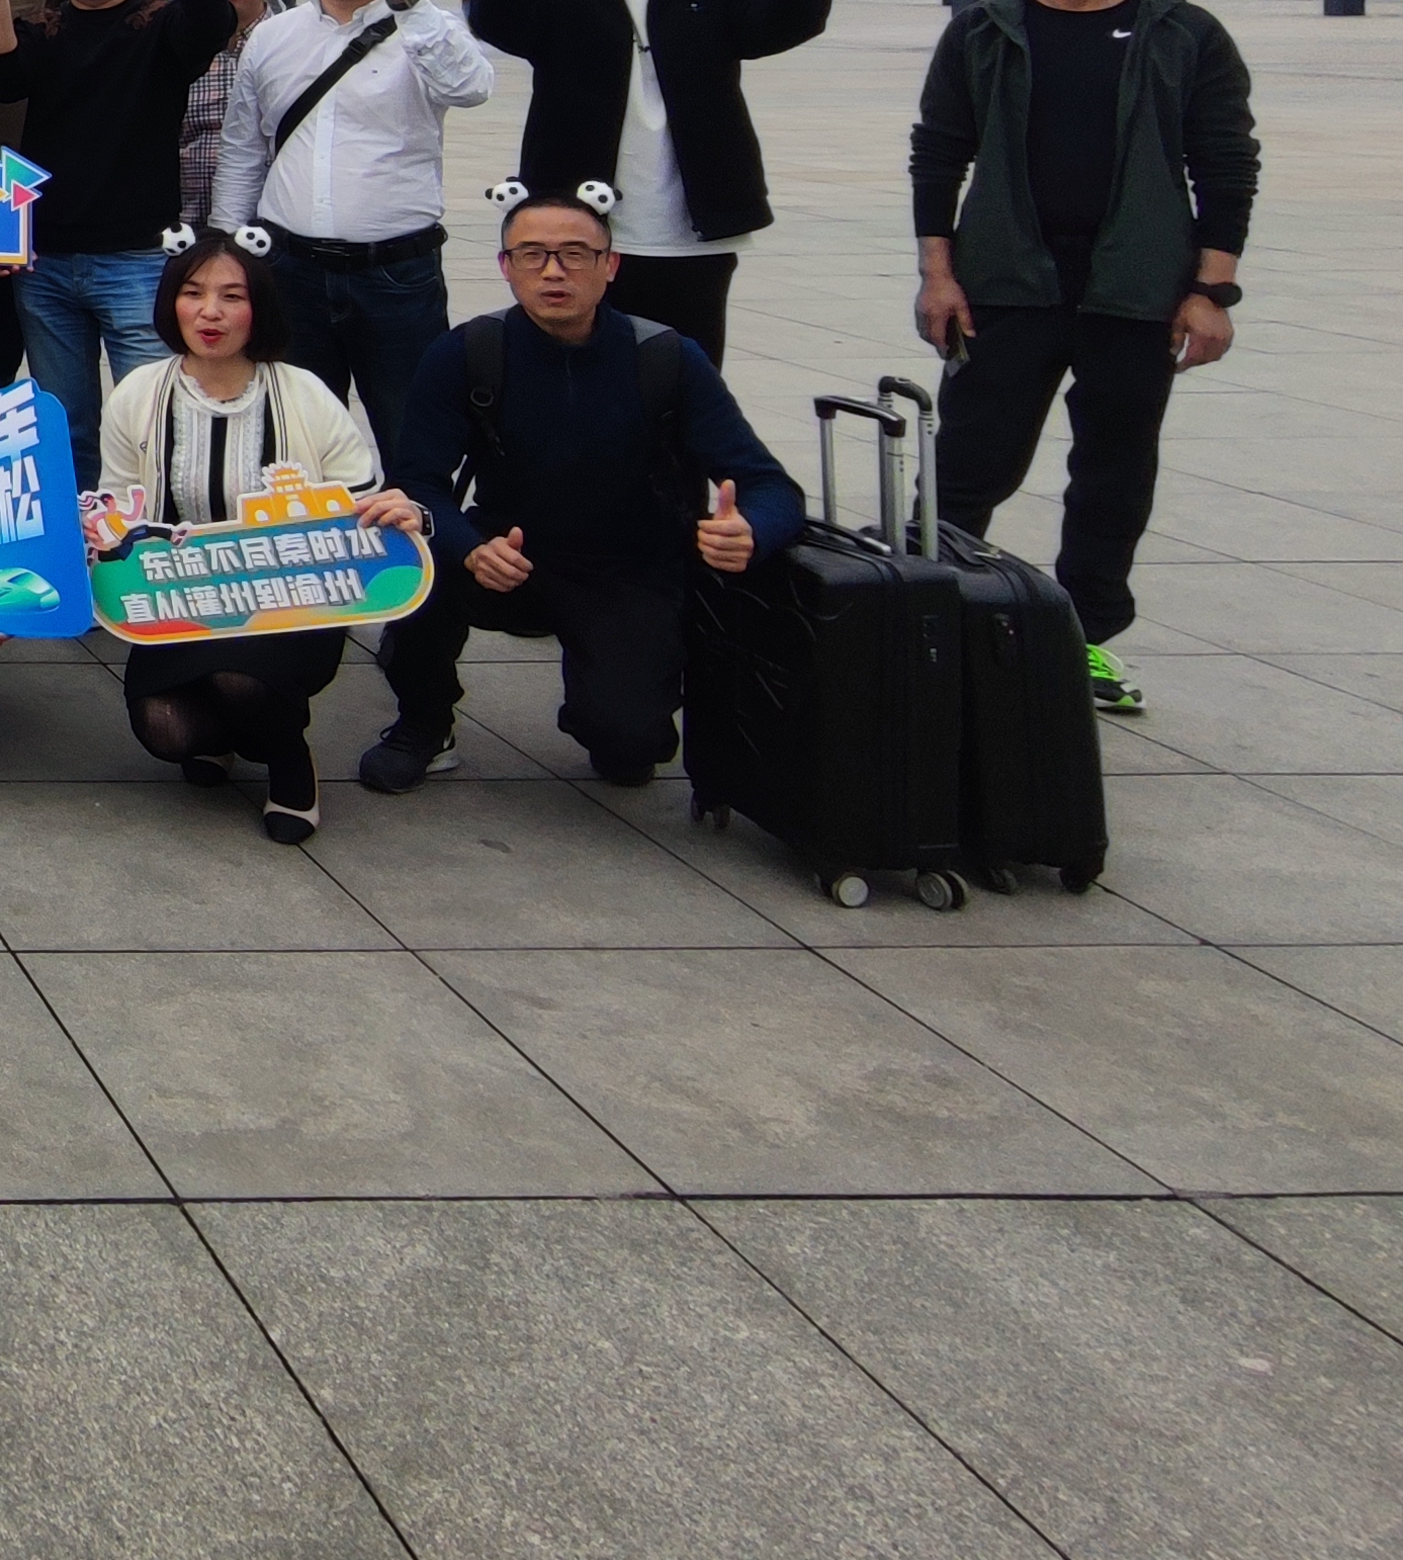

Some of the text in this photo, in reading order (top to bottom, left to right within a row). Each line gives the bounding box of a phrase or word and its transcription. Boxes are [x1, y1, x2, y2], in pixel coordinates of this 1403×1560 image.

[140, 525, 387, 578] 东流不尽秦时水
[121, 569, 363, 625] 直从灌州到渝州
